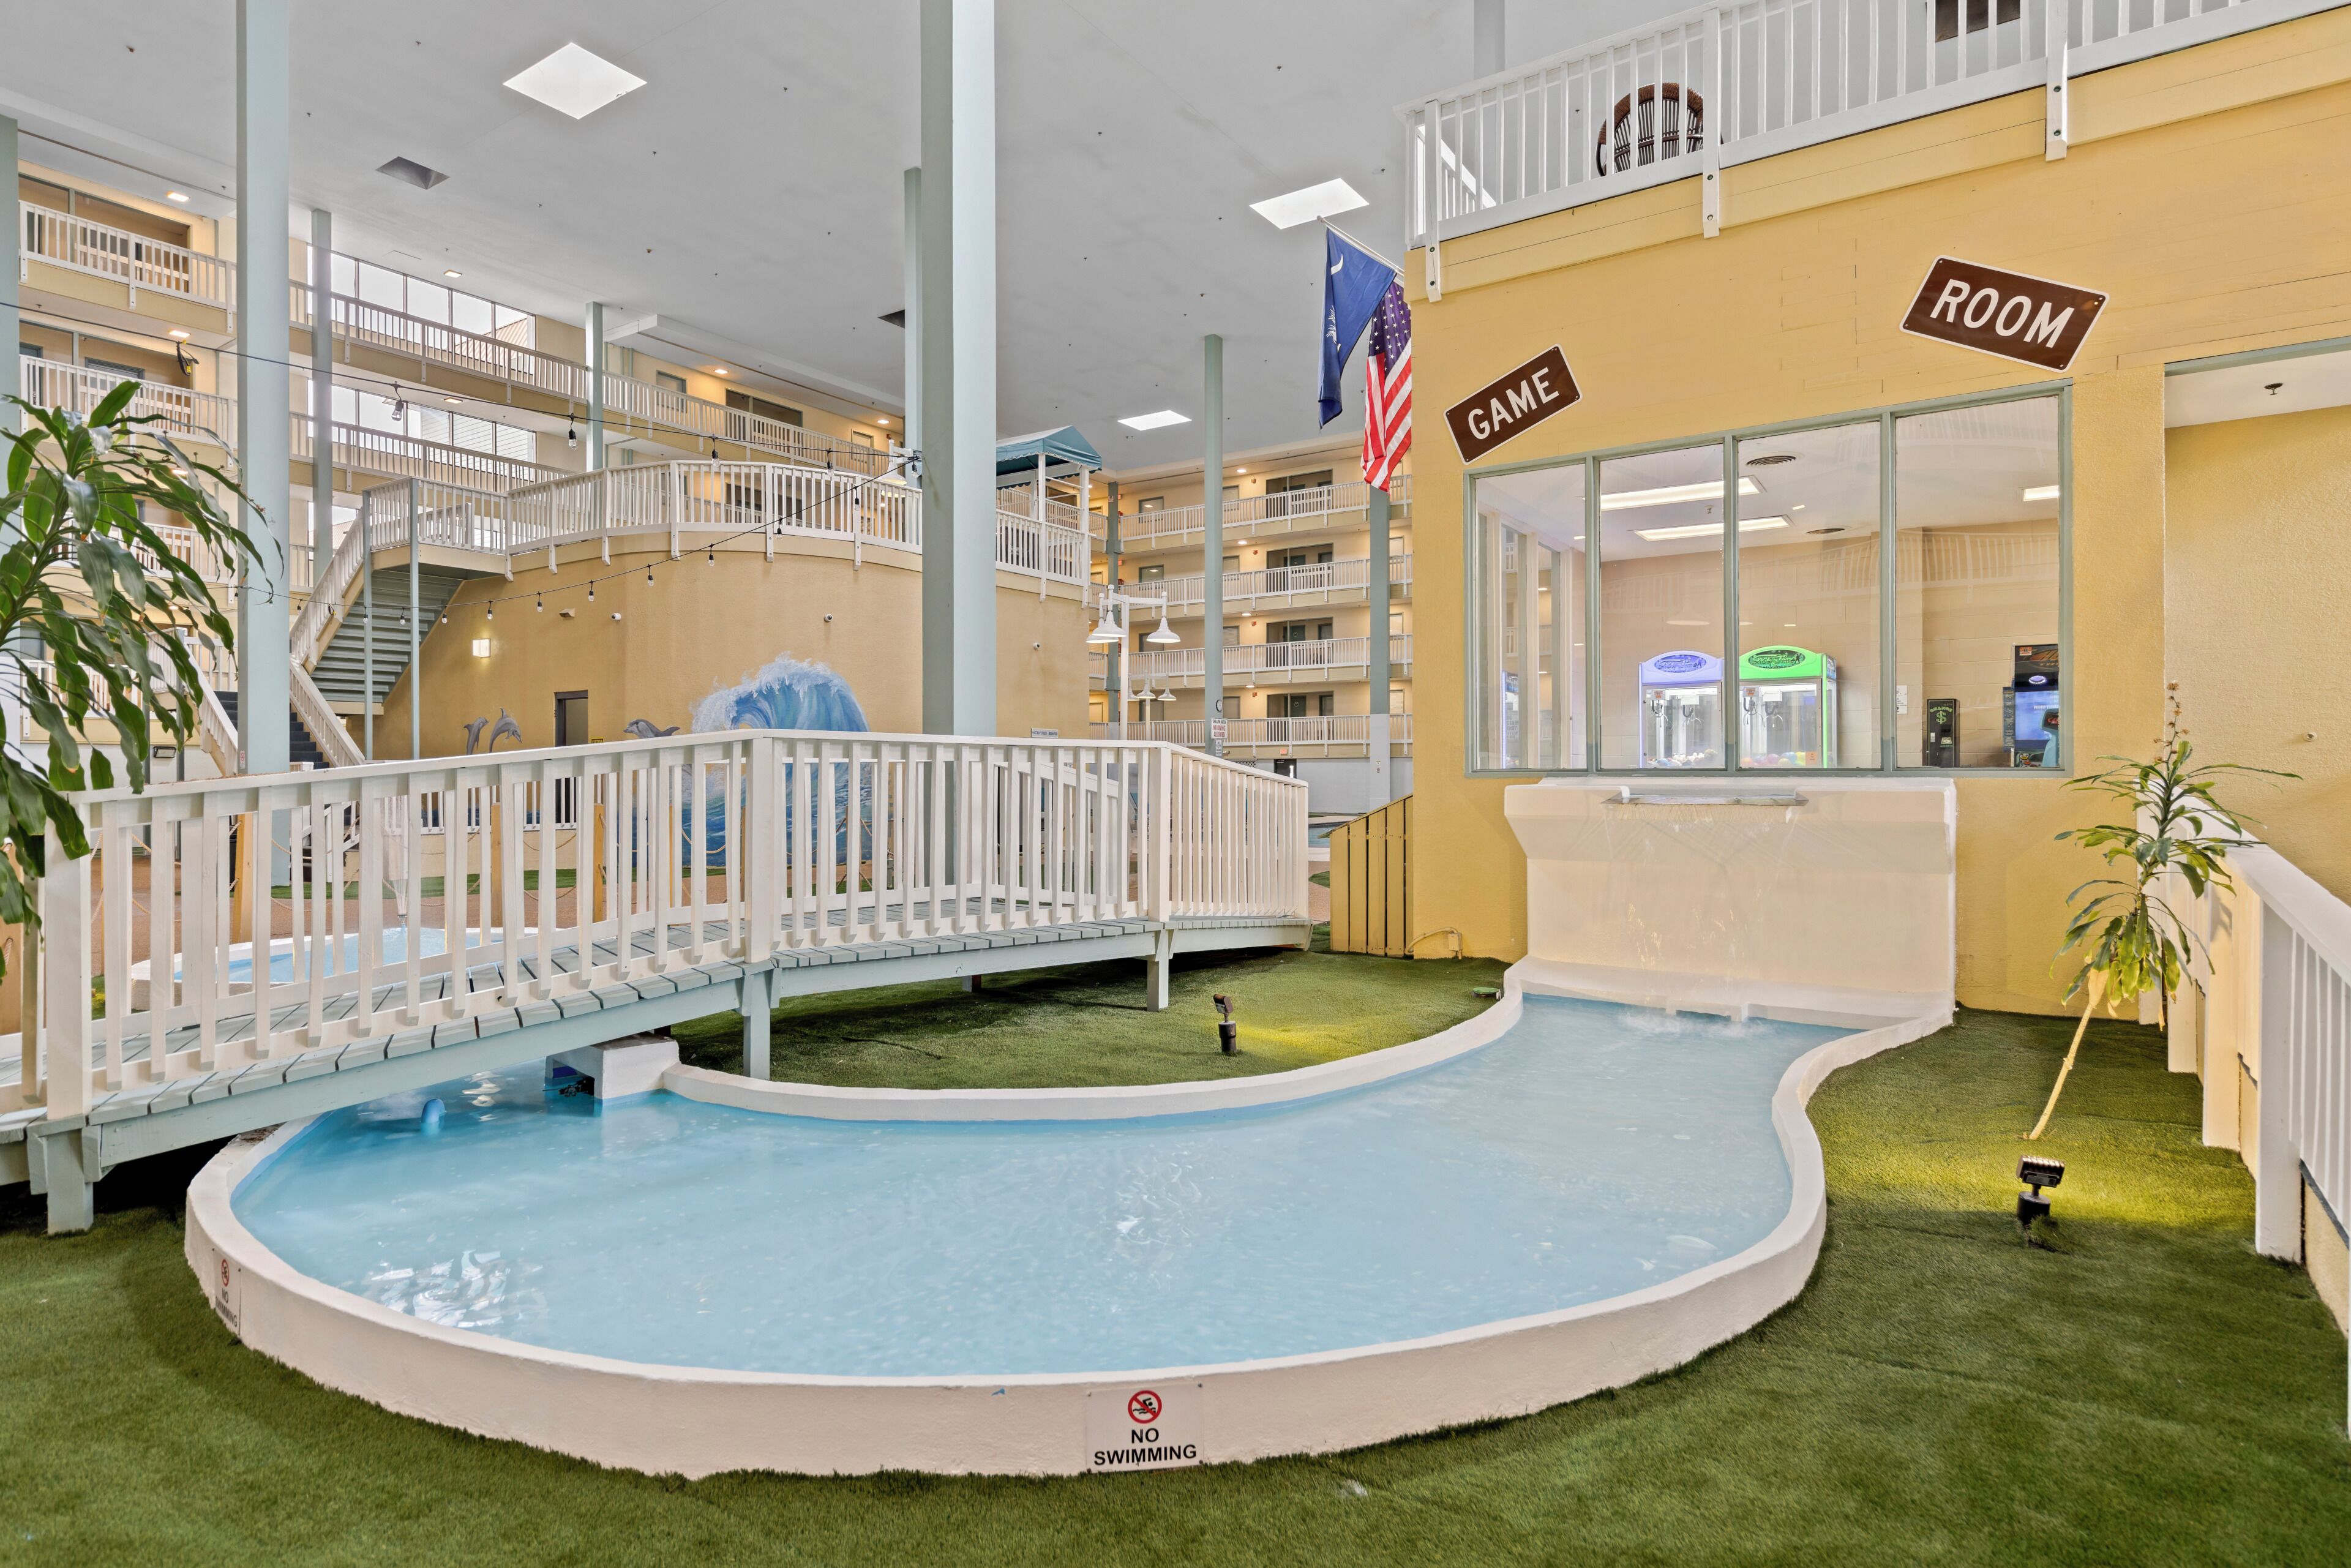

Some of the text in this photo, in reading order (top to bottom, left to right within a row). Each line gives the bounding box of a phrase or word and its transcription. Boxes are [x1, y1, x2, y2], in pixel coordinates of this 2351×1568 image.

[1930, 279, 2074, 348] ROOM
[1468, 366, 1559, 440] GAME
[222, 1288, 229, 1304] NO
[1131, 1428, 1160, 1444] NO
[1094, 1444, 1197, 1466] SWIMMING
